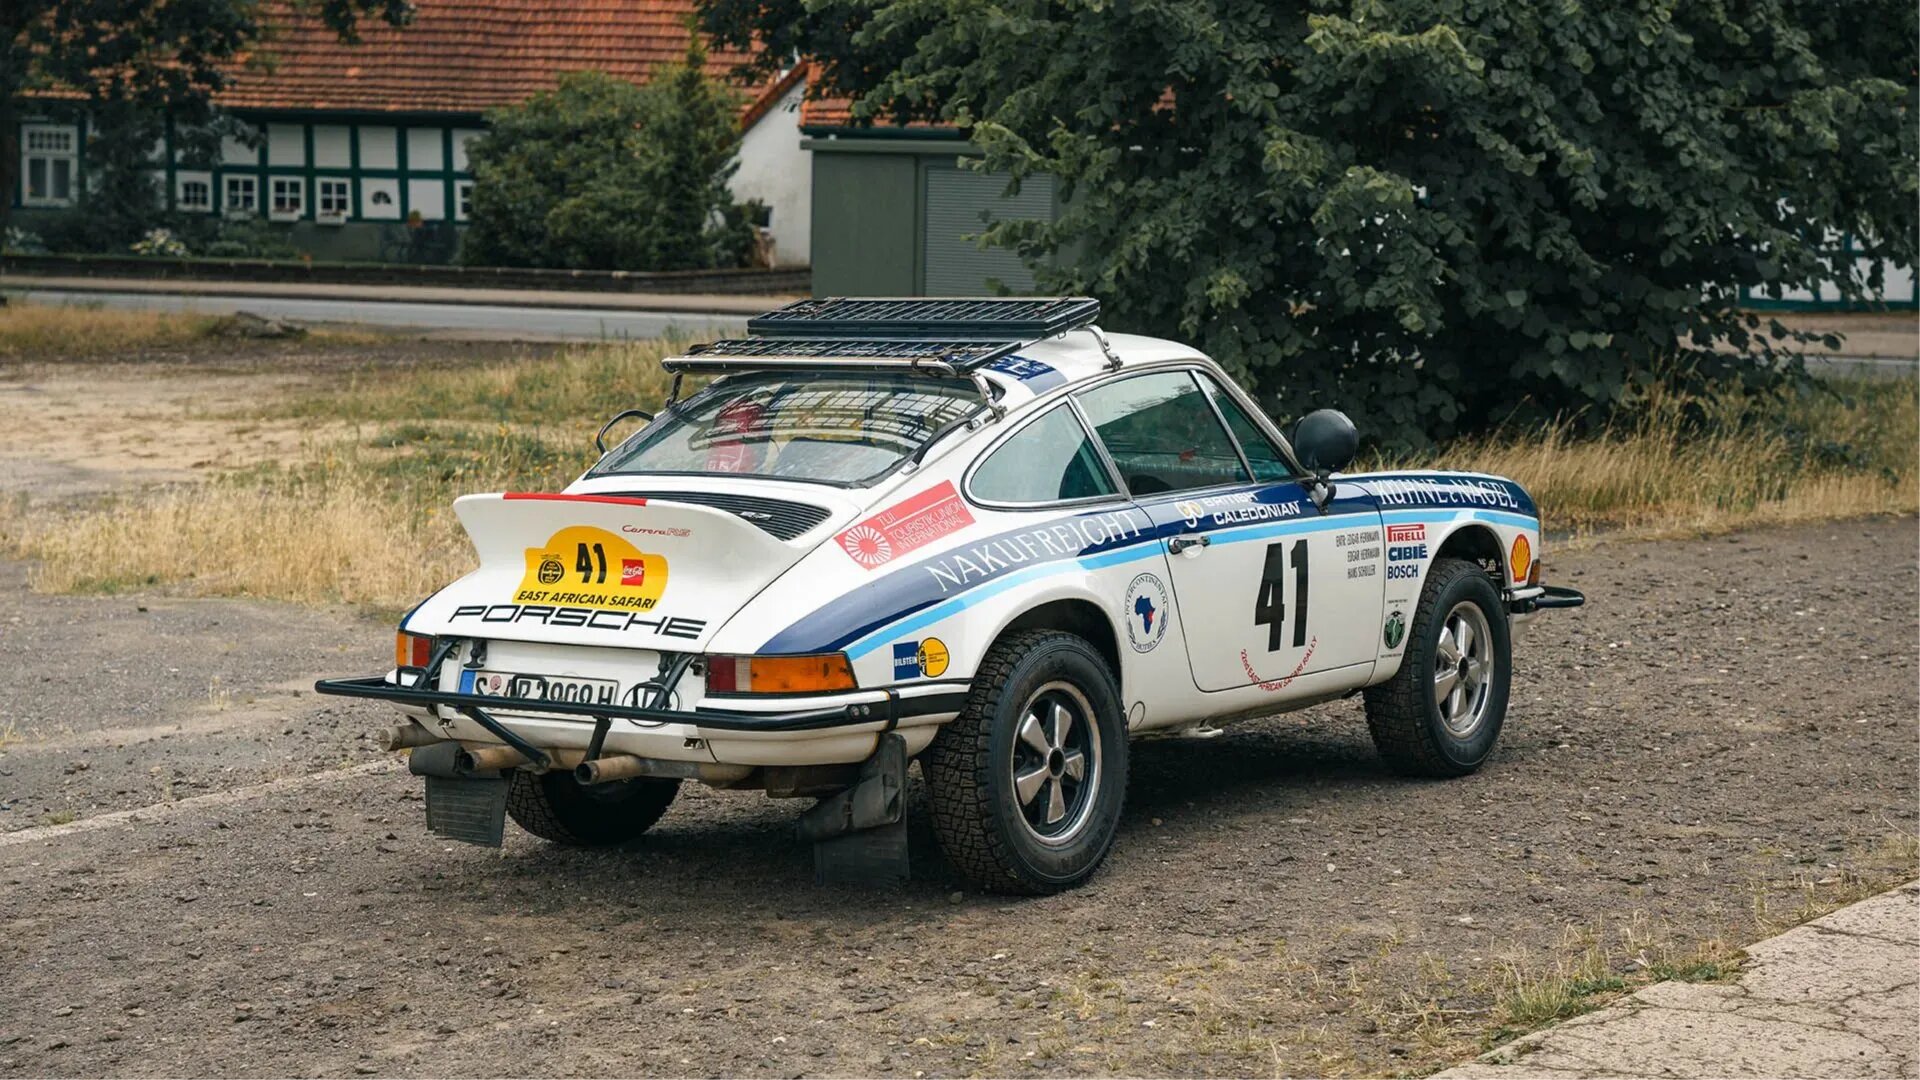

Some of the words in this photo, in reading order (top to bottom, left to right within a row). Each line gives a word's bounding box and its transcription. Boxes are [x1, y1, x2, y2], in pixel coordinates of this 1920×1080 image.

[1449, 479, 1518, 509] NAGEL
[877, 511, 896, 526] TUI
[889, 513, 935, 541] TOURISTIK
[935, 501, 965, 521] UNION
[1213, 501, 1301, 525] CALEDONIAN
[622, 525, 667, 536] Carrera
[897, 514, 965, 551] INTERNATIONAL
[1387, 524, 1426, 543] PIRELLI
[576, 543, 607, 584] 41
[924, 511, 1141, 592] NAKUFREIGHT
[1387, 564, 1419, 580] BOSCH
[517, 590, 549, 601] EAST
[549, 592, 607, 605] AFRICAN
[609, 595, 657, 609] SAFARI
[1255, 539, 1309, 653] 41
[448, 605, 707, 640] PORSCHE
[894, 656, 918, 667] BILSTEIN
[1302, 635, 1318, 667] RALLY
